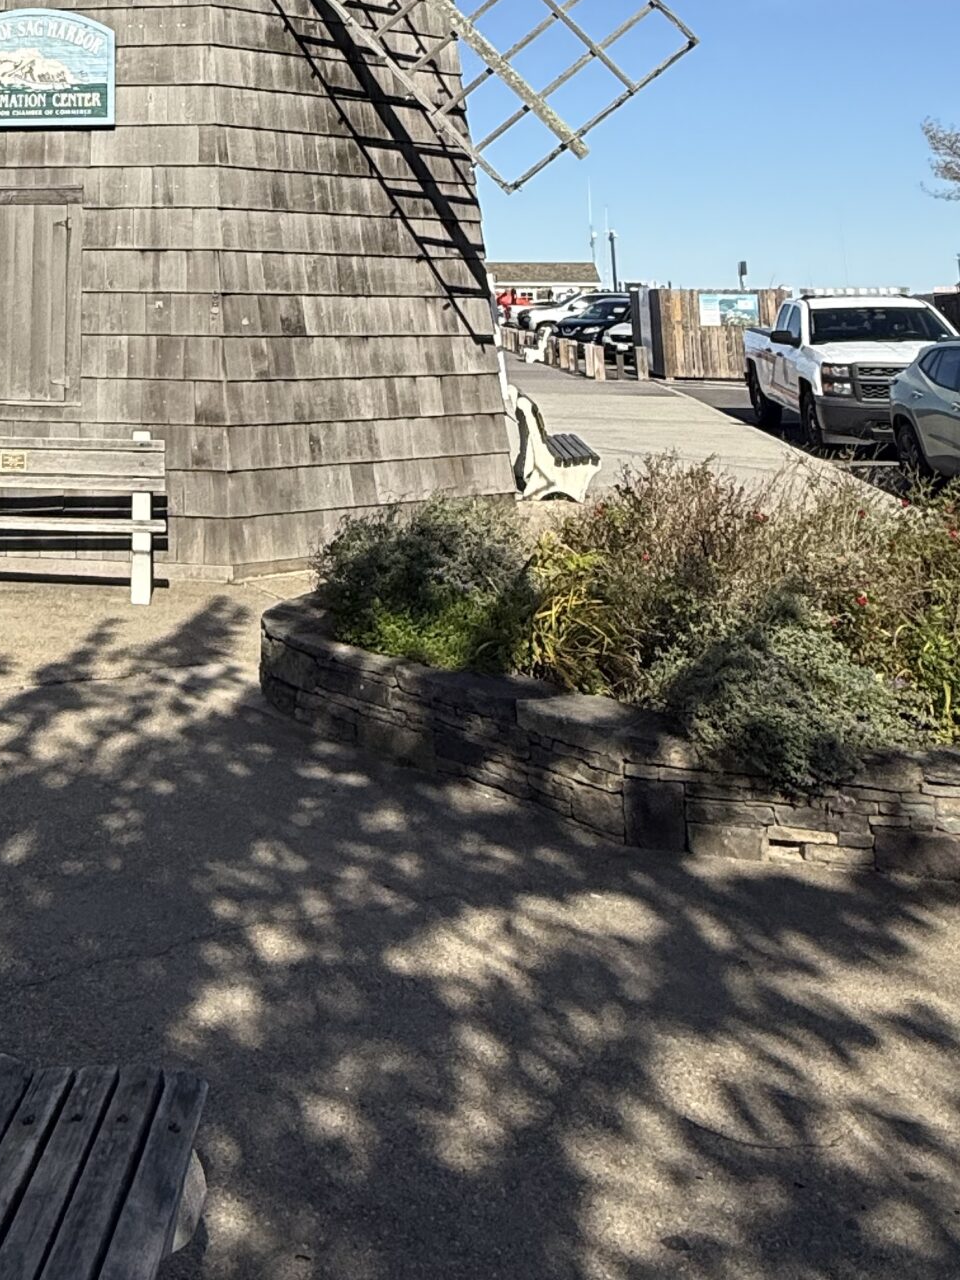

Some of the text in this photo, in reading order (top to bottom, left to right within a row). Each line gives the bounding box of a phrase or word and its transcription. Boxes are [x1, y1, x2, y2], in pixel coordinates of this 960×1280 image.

[18, 20, 43, 37] SAG
[47, 21, 104, 55] HARBOR
[52, 92, 101, 107] CENTER
